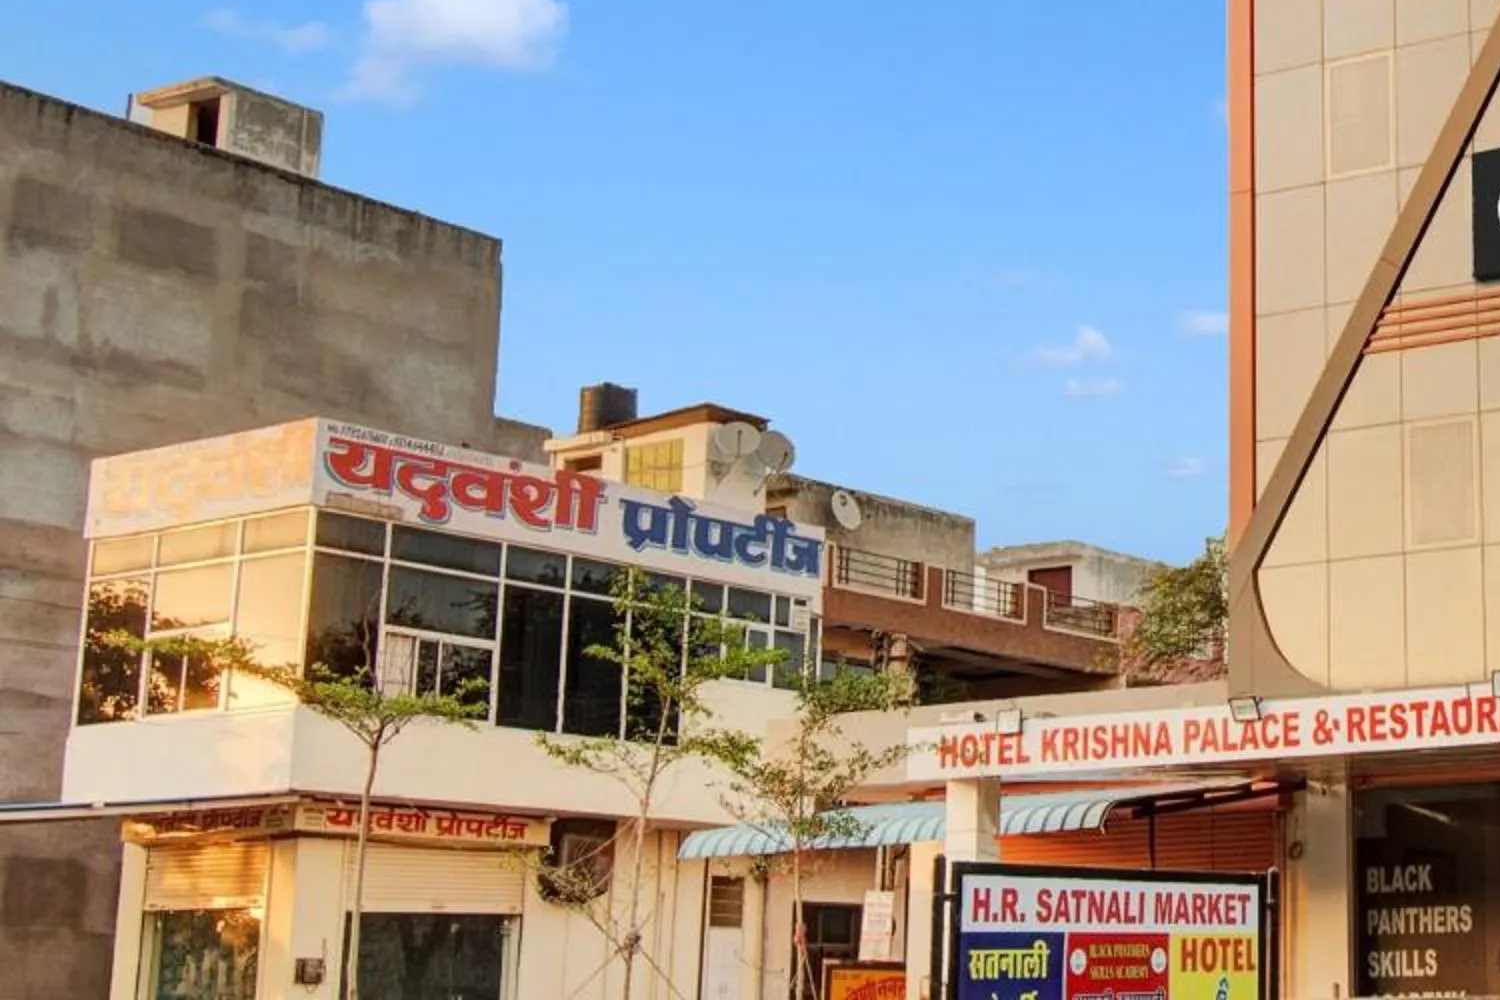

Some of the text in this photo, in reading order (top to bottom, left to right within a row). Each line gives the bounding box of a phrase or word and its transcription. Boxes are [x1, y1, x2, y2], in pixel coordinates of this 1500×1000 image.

[325, 437, 608, 536] यदुवंशी
[938, 731, 1031, 770] HOTEL
[1040, 717, 1173, 764] KRISHNA
[1182, 710, 1300, 754] PALACE
[1311, 708, 1339, 746] &
[1366, 864, 1433, 894] BLACK
[971, 886, 1252, 926] H.R. SATNALI MARKET
[1366, 904, 1473, 936] PANTHERS
[967, 939, 1051, 980] सतनाली
[1180, 937, 1256, 973] HOTEL
[1367, 948, 1439, 979] SKILLS
